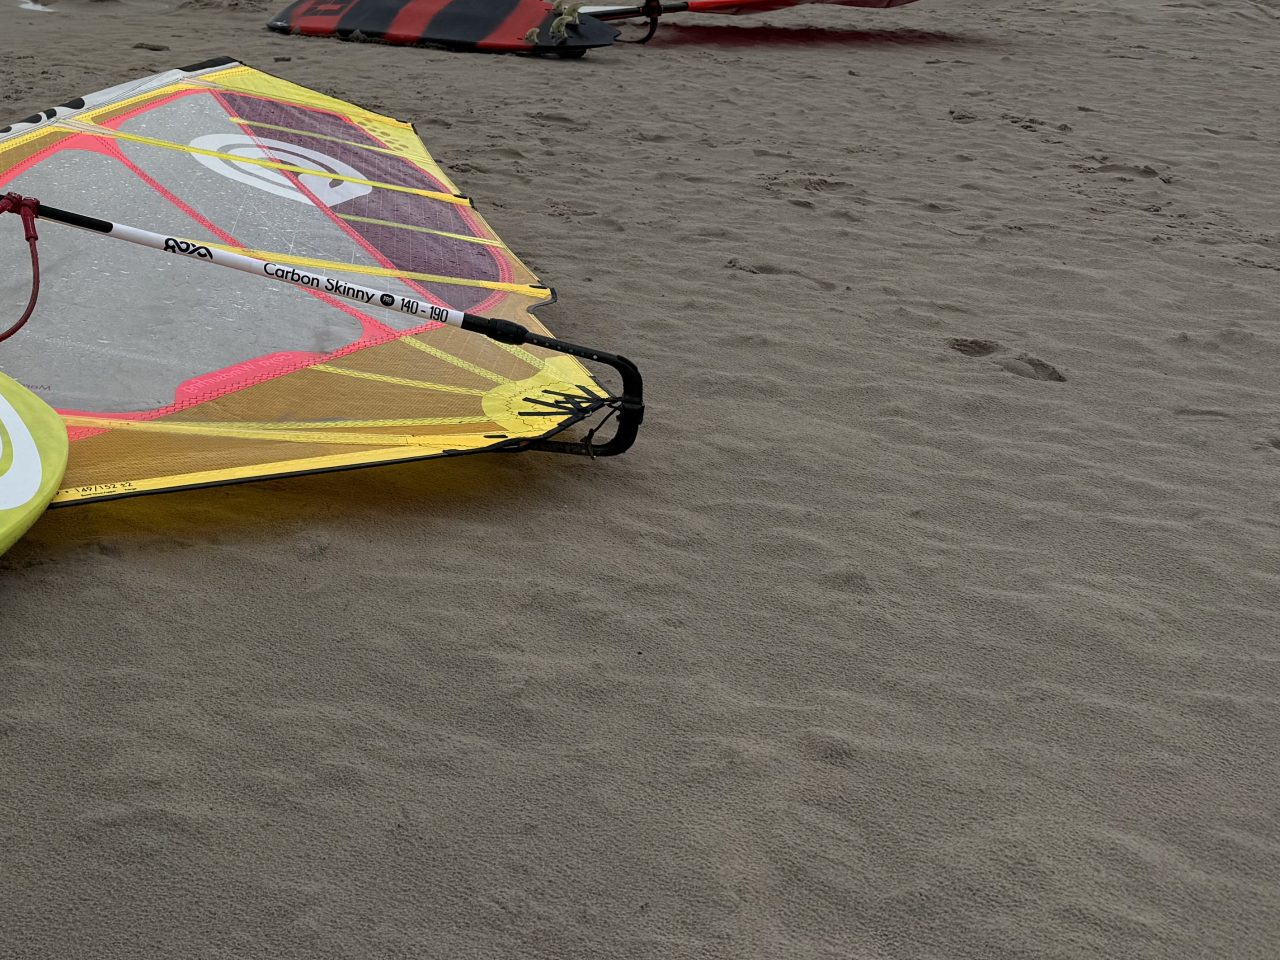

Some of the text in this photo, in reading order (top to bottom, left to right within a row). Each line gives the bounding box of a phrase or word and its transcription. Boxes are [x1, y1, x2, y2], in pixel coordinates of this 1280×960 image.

[263, 262, 321, 288] Carbon
[324, 278, 375, 304] Skinny
[400, 297, 419, 315] 140
[429, 305, 449, 323] 190
